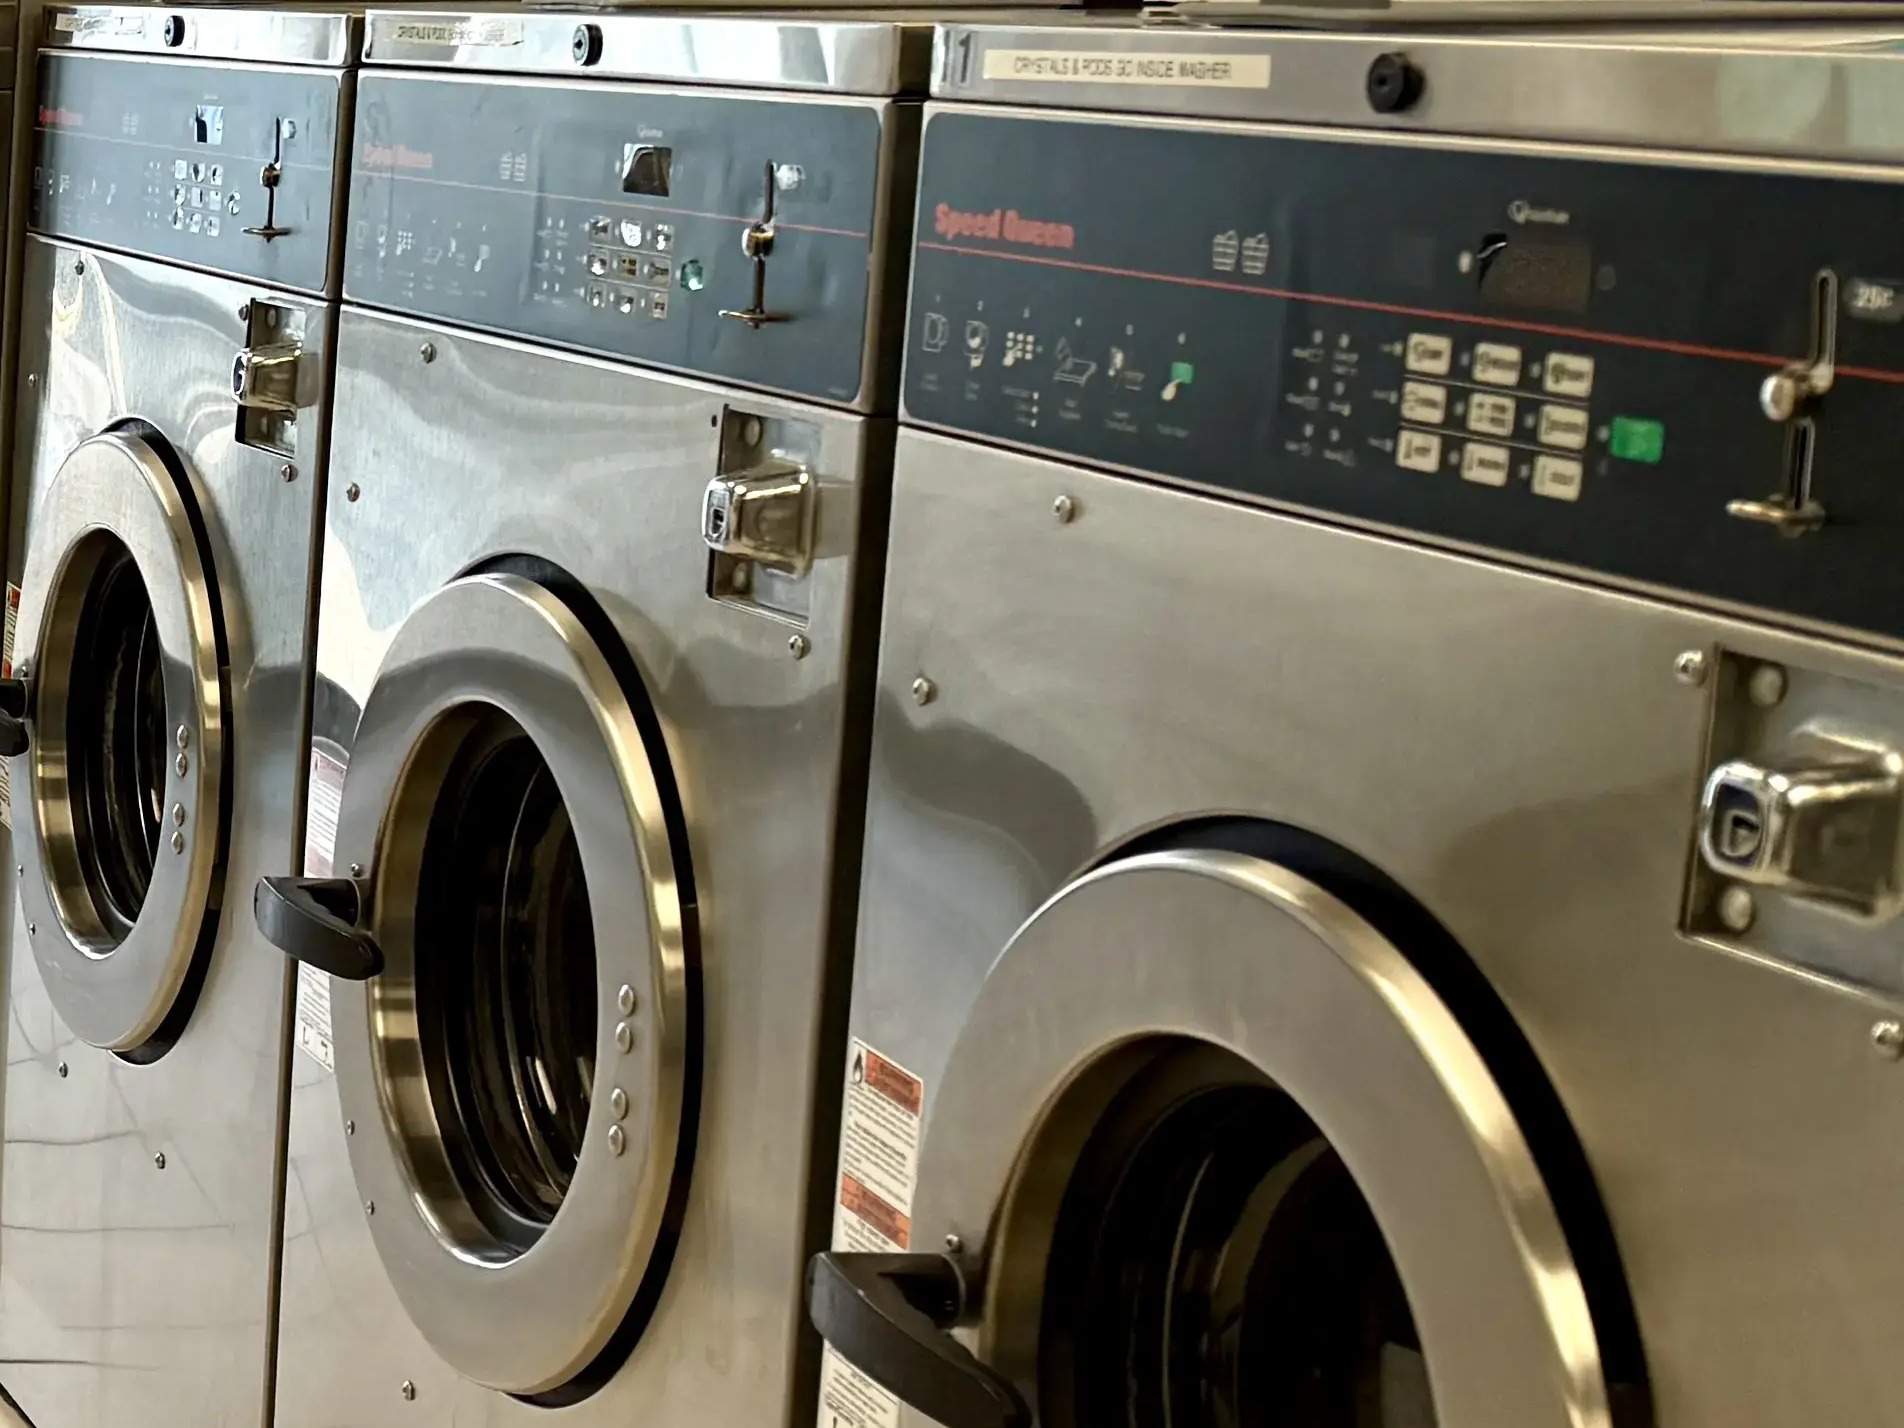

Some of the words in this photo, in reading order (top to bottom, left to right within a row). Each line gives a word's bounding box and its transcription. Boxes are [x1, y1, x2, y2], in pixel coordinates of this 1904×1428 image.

[1013, 56, 1069, 76] CRYSTALS
[934, 202, 1002, 240] Speed
[1002, 209, 1075, 248] Queen
